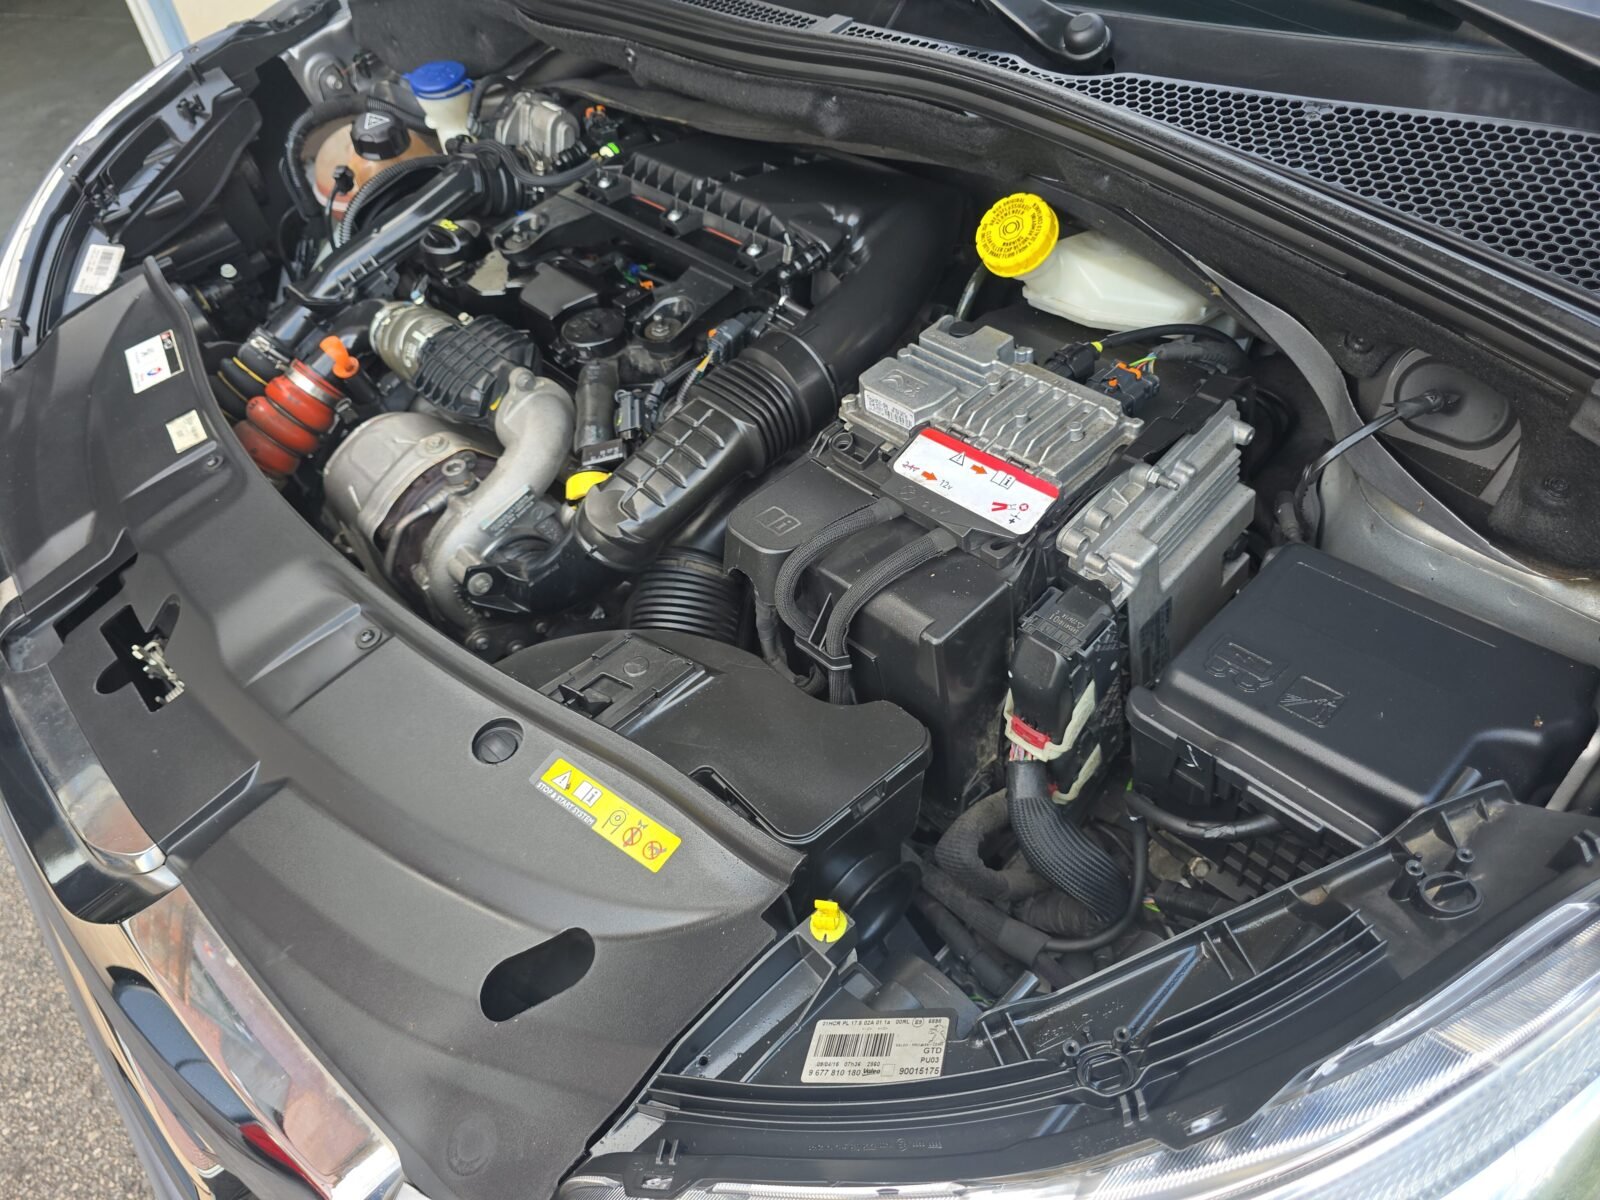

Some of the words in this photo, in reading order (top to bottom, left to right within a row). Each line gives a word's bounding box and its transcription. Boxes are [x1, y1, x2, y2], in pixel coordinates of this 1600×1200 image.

[536, 782, 554, 796] STOP
[556, 795, 577, 812] START
[573, 808, 595, 824] SYSTEM
[899, 1067, 940, 1075] 90015175
